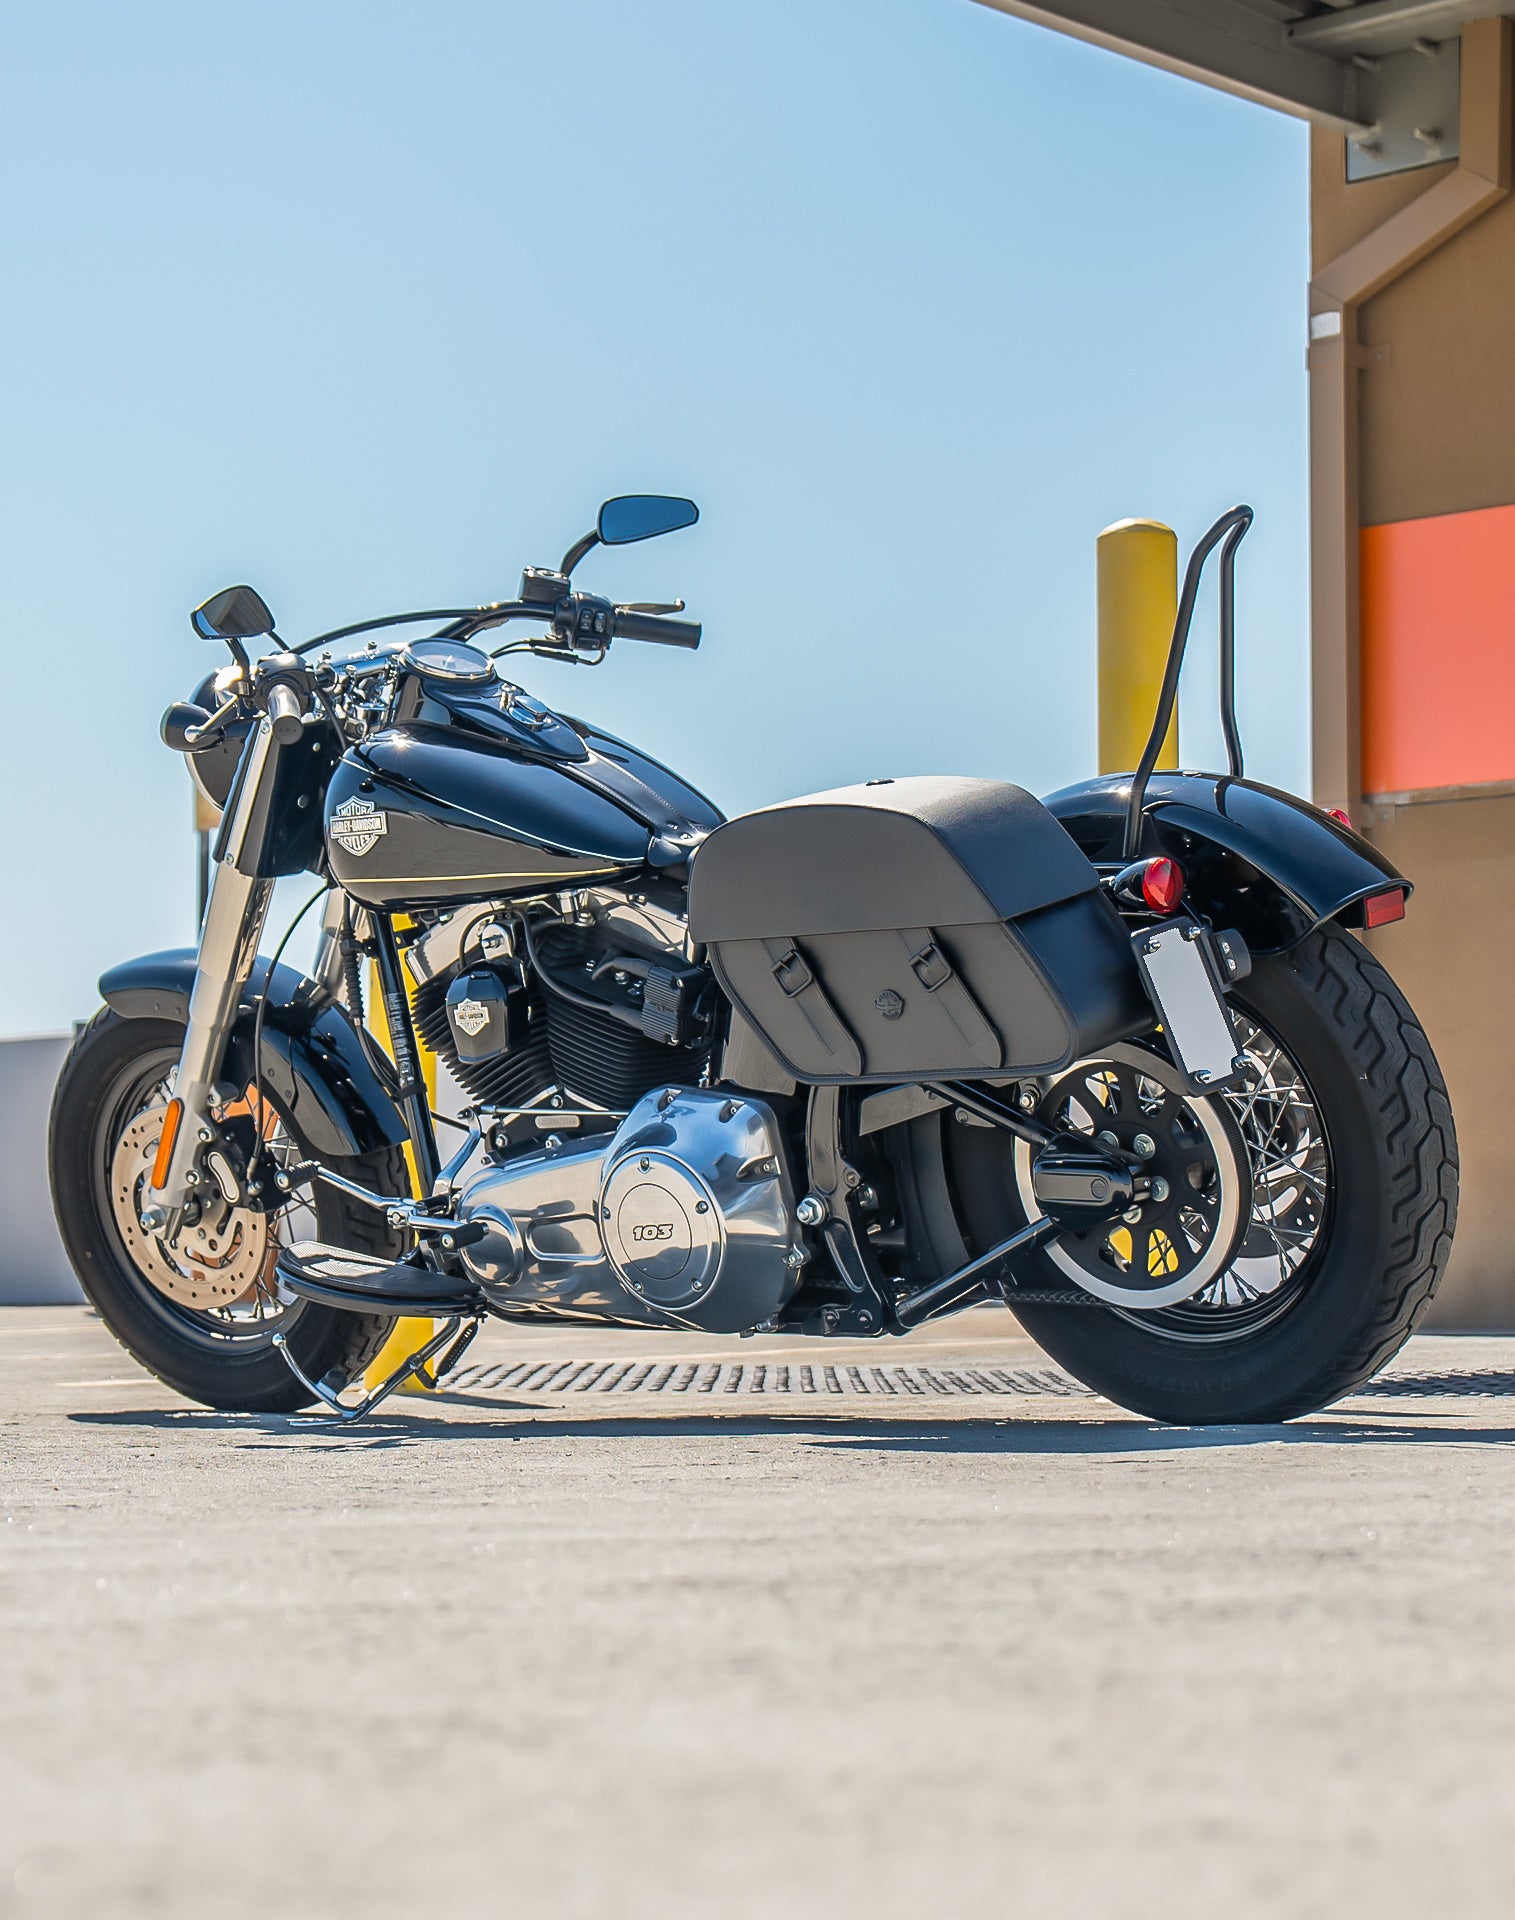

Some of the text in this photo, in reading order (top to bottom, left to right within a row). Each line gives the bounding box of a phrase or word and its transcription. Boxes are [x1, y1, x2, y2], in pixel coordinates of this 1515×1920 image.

[341, 803, 367, 816] MOTOR
[332, 817, 381, 833] HARLEY-DAVIDSON
[343, 834, 370, 850] CYCLES
[633, 1224, 674, 1241] 103
